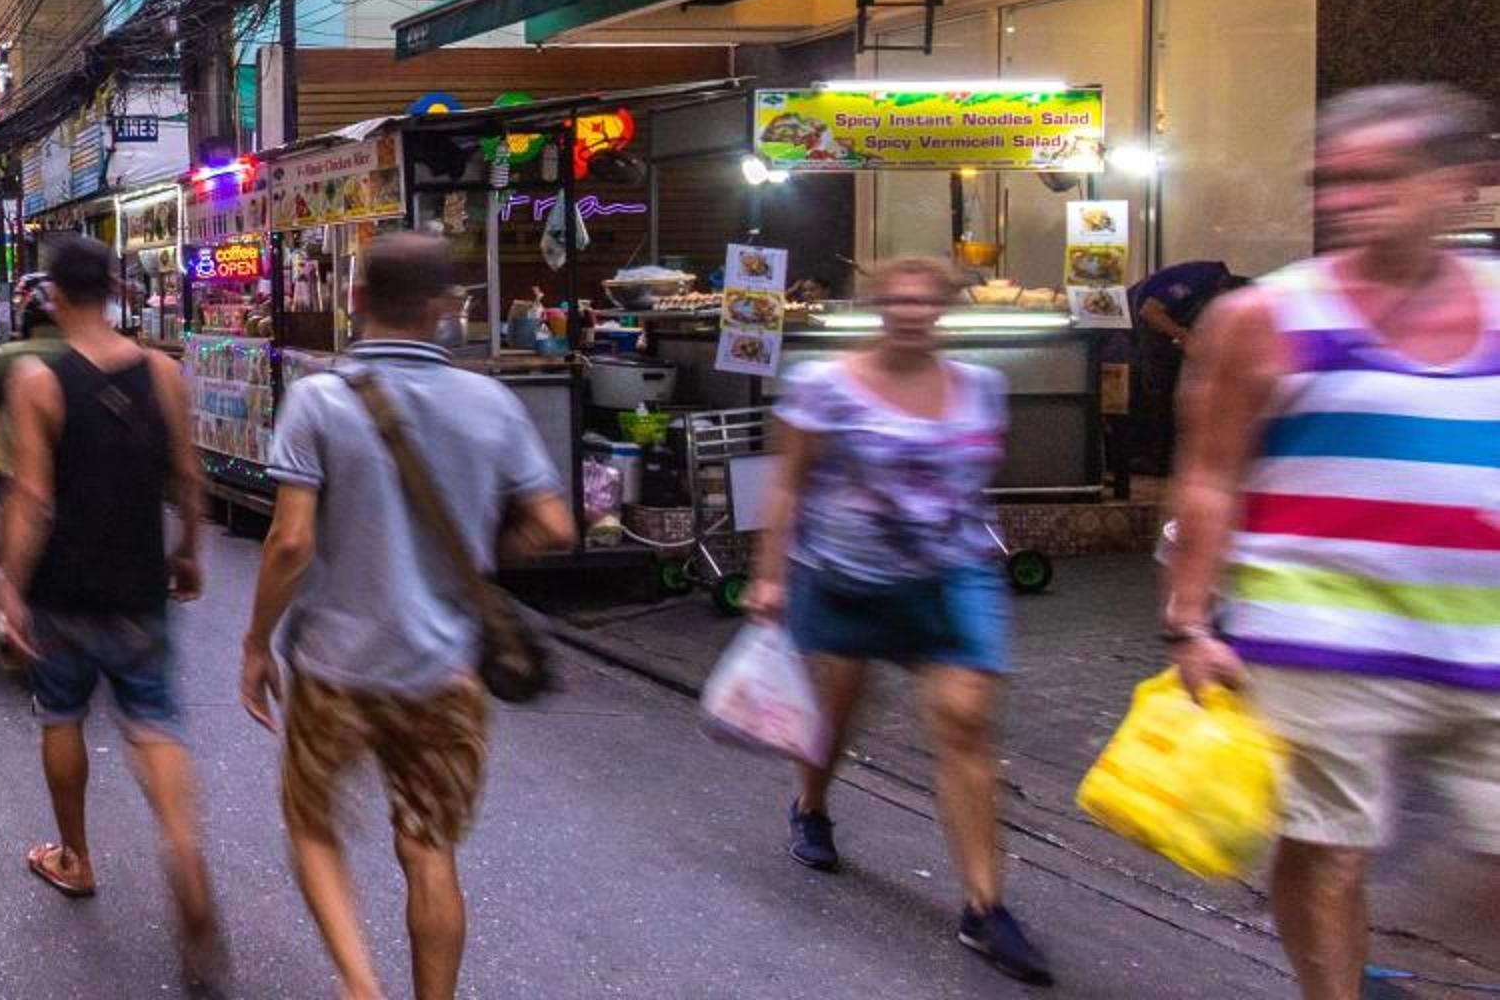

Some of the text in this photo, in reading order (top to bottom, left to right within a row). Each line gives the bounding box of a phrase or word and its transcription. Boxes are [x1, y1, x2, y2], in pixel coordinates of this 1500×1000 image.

[835, 112, 1089, 128] Spicy Instant Noodles Salad
[865, 135, 1061, 150] Spicy Vermicelli Salad
[215, 245, 258, 261] coffee
[218, 260, 258, 277] OPEN
